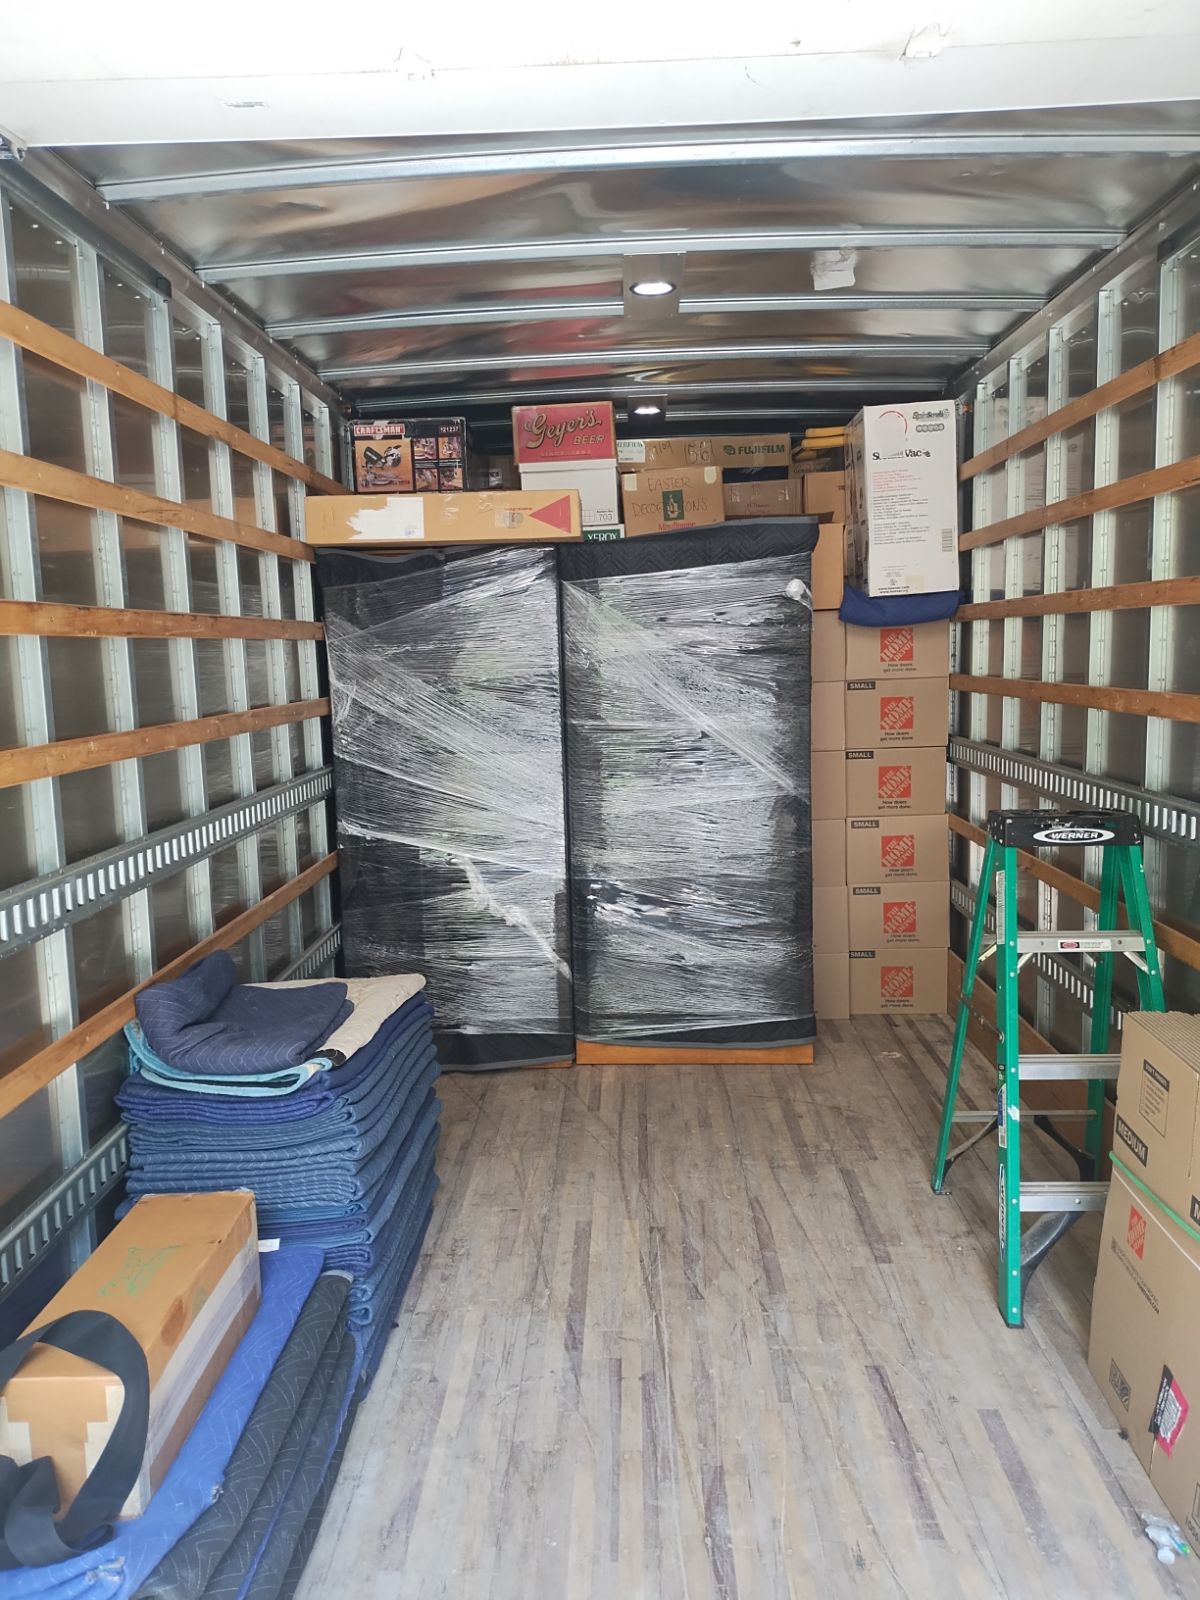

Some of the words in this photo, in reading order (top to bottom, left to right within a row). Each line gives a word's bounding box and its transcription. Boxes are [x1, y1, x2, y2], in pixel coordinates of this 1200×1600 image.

[355, 426, 401, 434] CRAFTSMAN
[524, 409, 602, 449] Geyer's
[573, 434, 605, 445] BEER
[738, 444, 785, 455] FUJIFILM
[648, 477, 693, 492] EASTER
[599, 513, 613, 521] 703
[1118, 1119, 1146, 1161] MEDIUM
